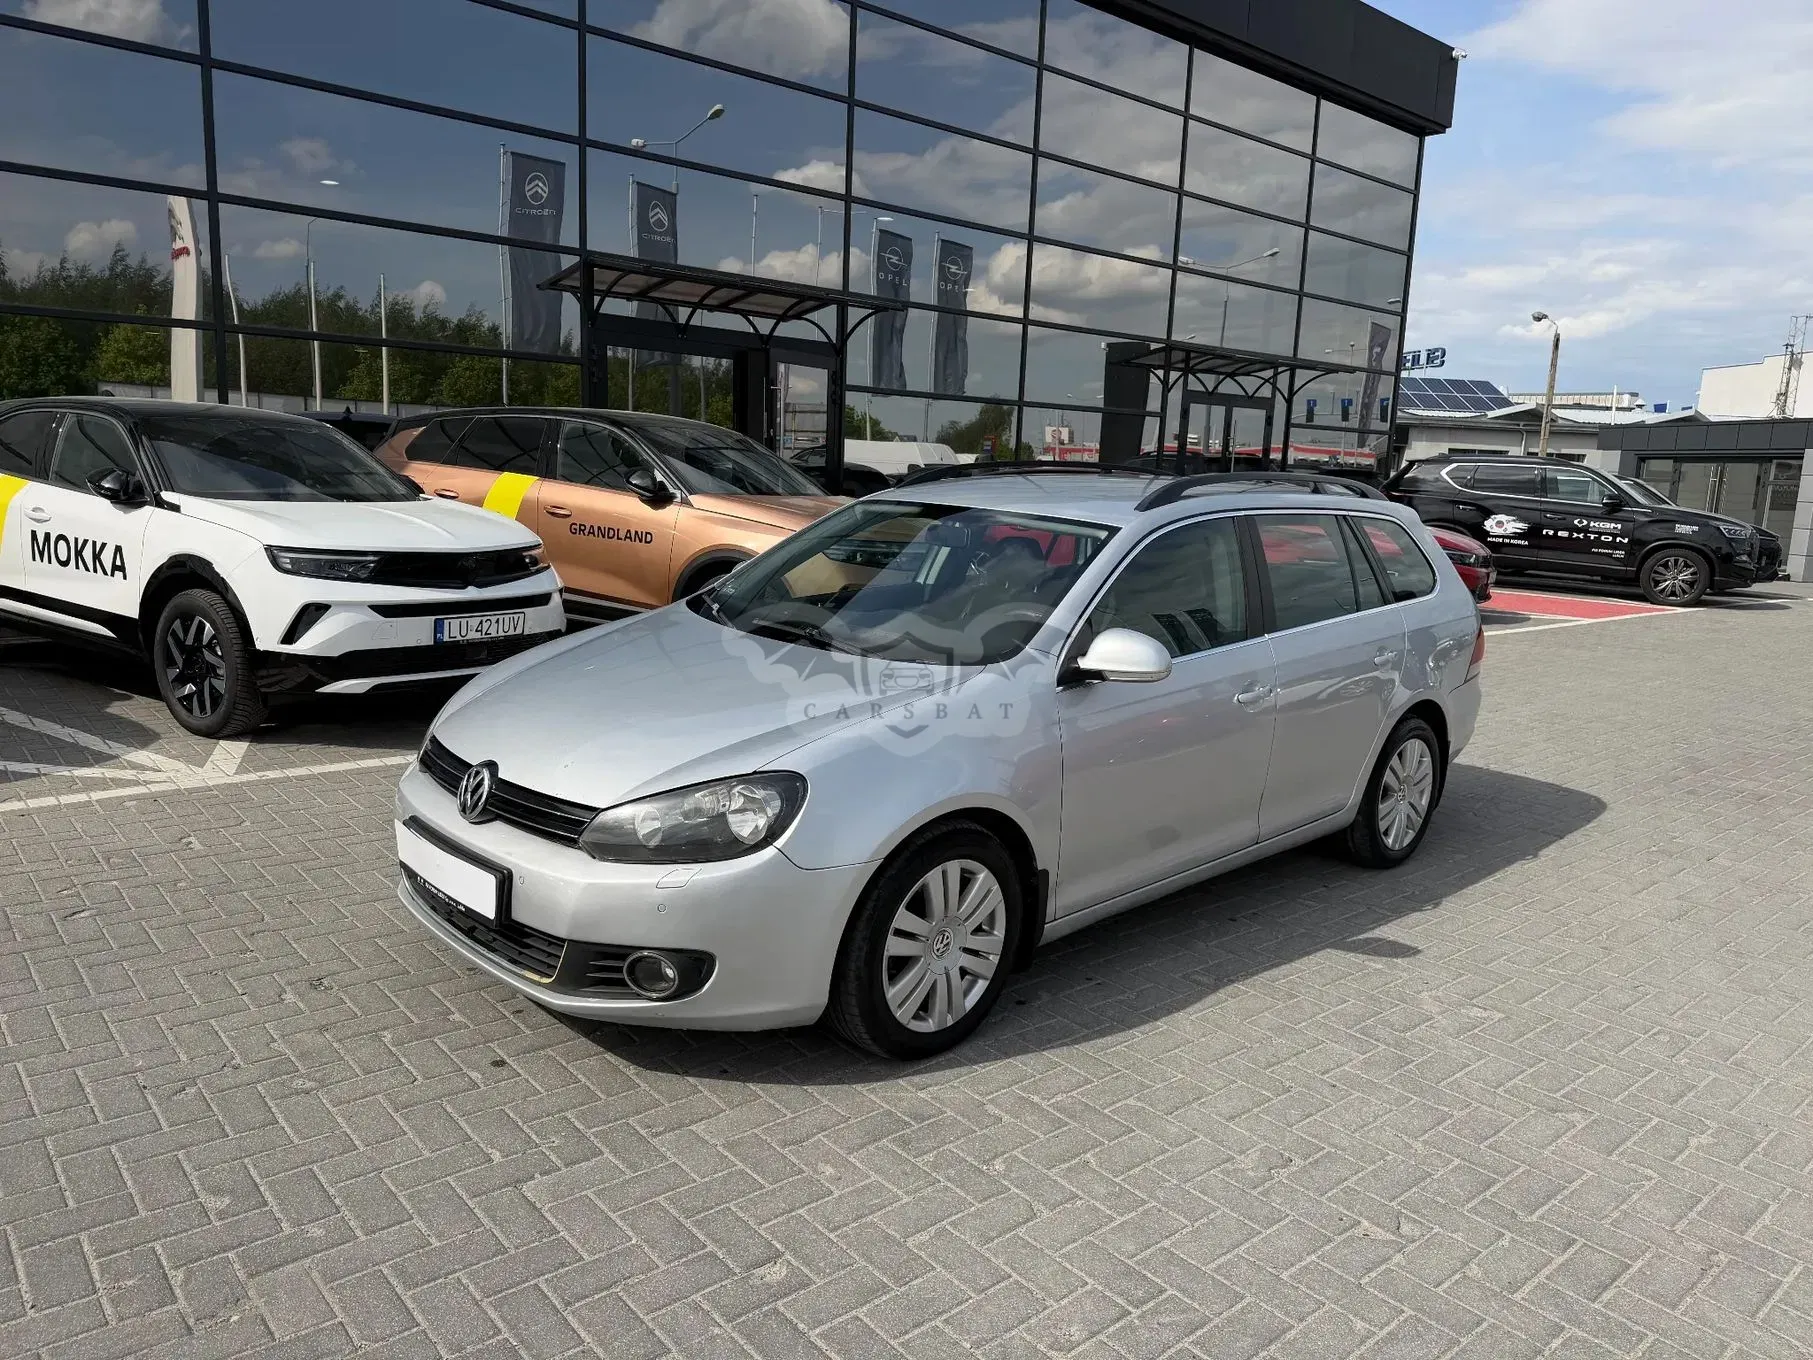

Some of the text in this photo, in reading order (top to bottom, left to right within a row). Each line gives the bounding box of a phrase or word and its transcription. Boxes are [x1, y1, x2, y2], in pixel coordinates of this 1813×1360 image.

[878, 271, 908, 287] OPEL
[569, 522, 653, 544] GRANDLAND
[1589, 520, 1622, 530] KGM
[1542, 529, 1629, 544] REXTON
[30, 529, 127, 581] MOKKA
[448, 615, 521, 640] LU 421UV
